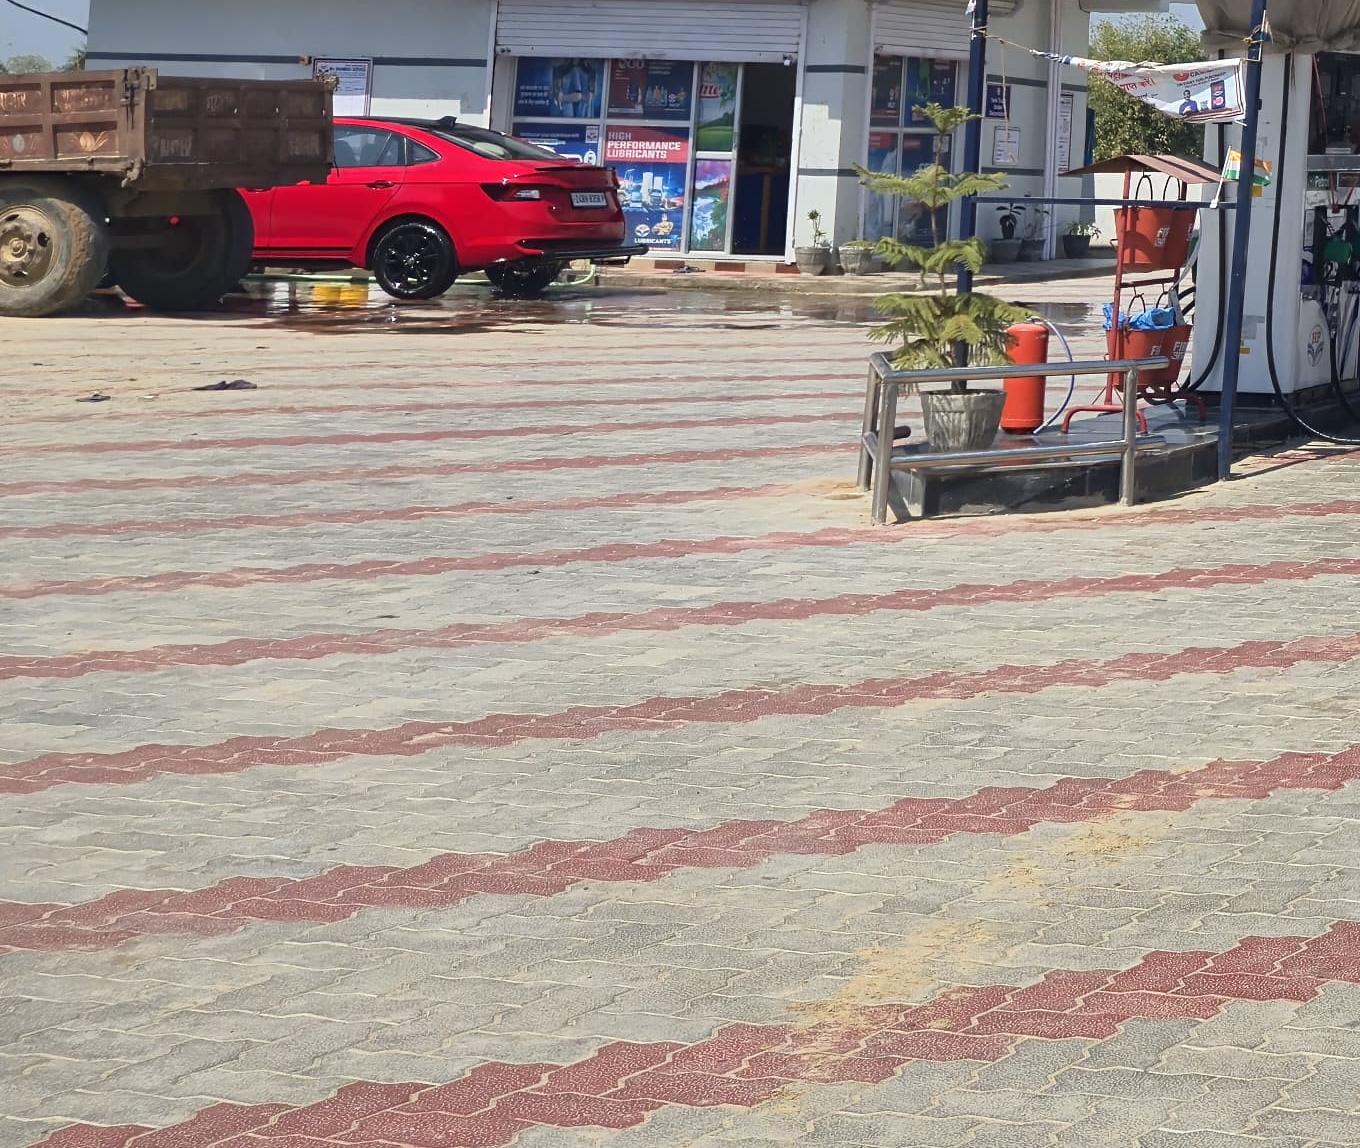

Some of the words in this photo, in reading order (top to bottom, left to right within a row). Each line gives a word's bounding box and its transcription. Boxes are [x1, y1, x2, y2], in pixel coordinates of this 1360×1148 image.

[608, 132, 631, 140] HIGH
[607, 140, 681, 150] PERFORMANCE
[607, 149, 667, 159] LUBRICANTS
